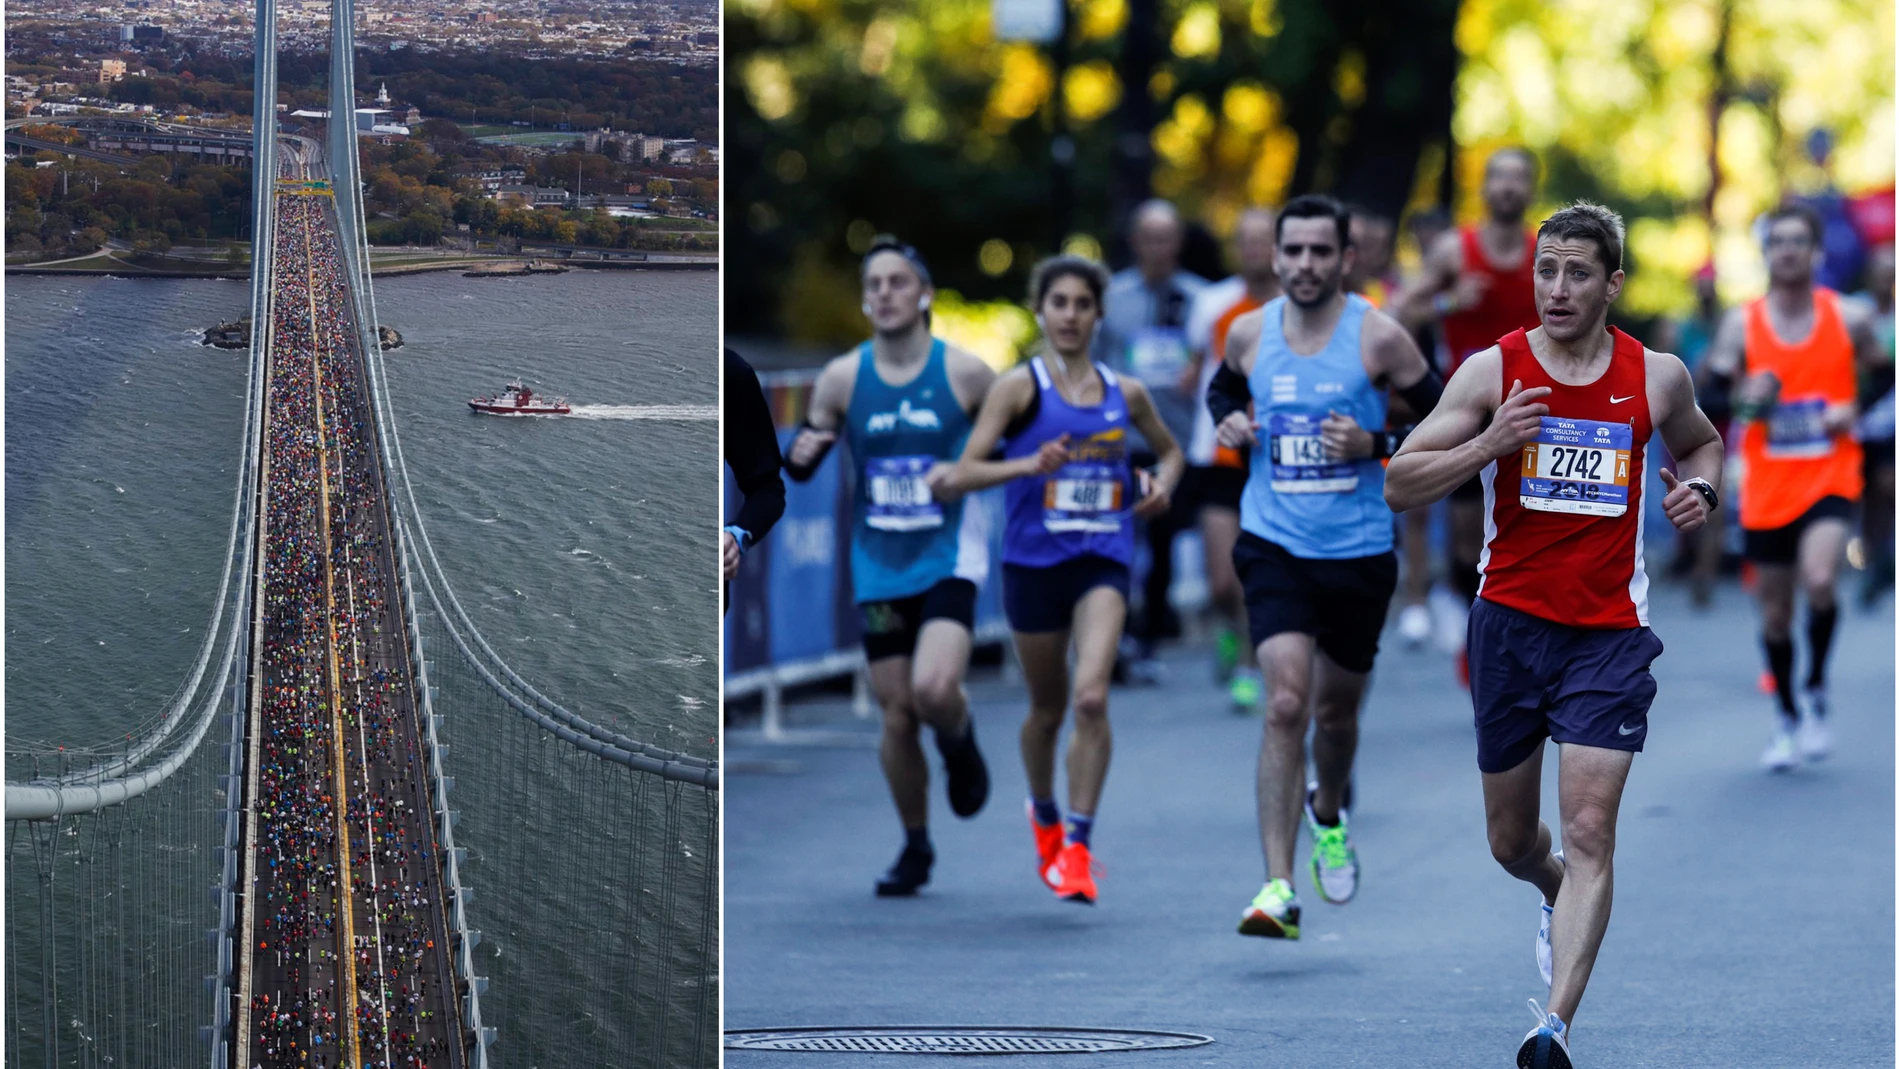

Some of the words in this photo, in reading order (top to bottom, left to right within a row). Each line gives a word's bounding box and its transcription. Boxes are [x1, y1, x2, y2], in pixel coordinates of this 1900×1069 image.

[1545, 428, 1587, 437] CONSULTANCY
[1550, 447, 1602, 480] 2742
[1618, 461, 1627, 478] A
[1549, 481, 1600, 500] 2018
